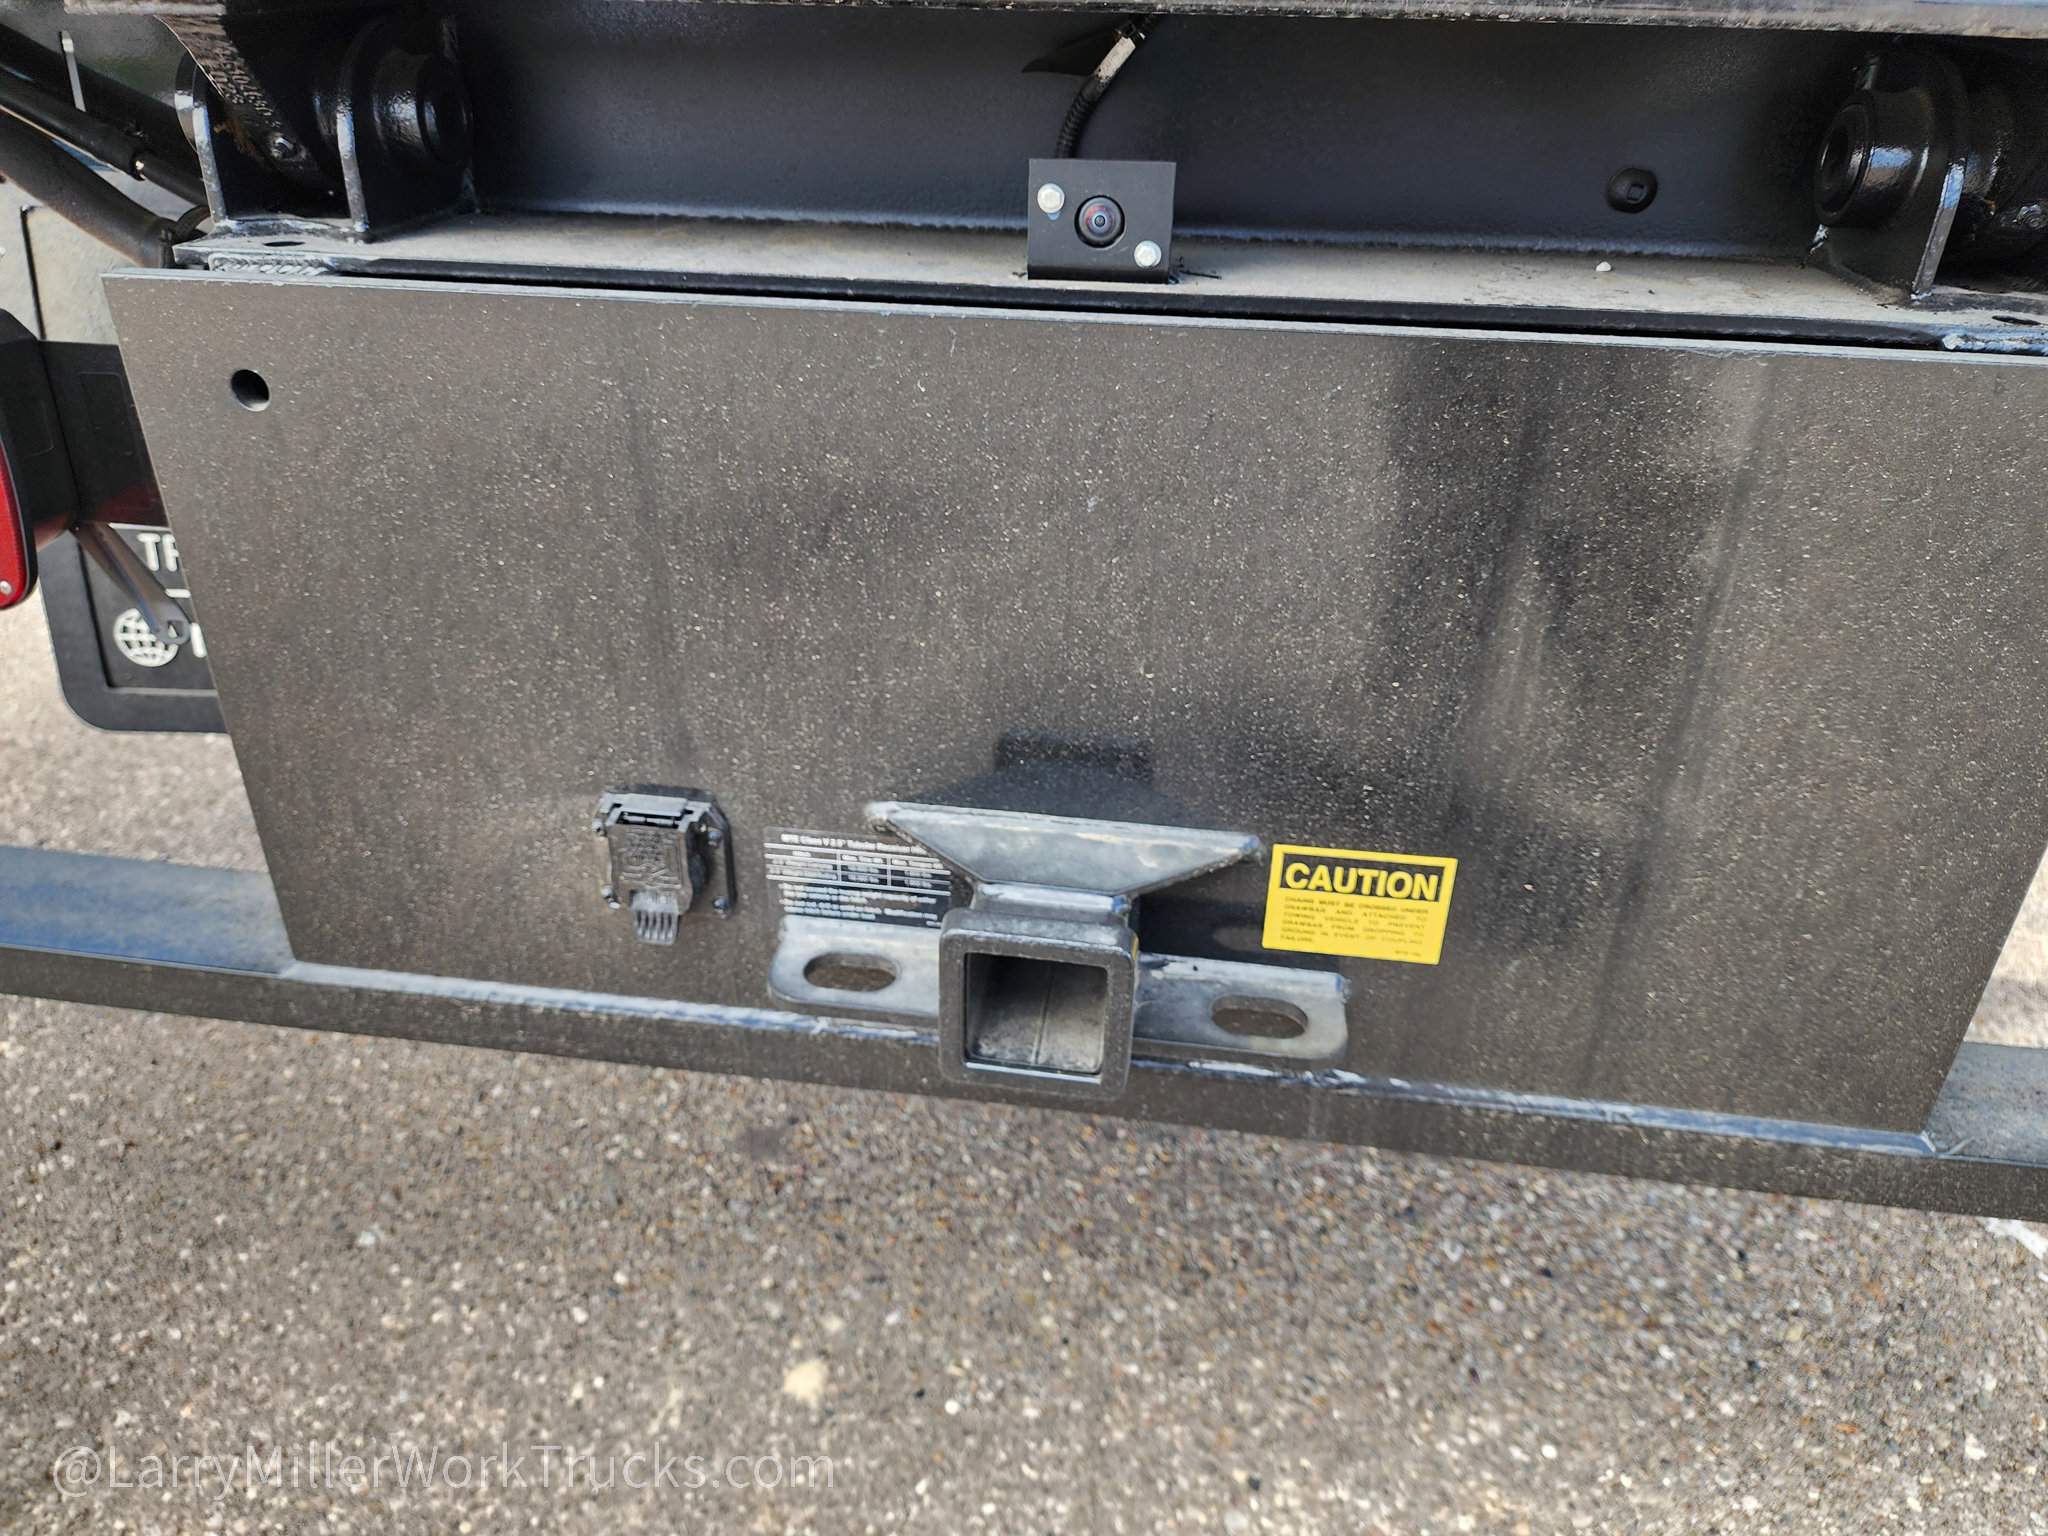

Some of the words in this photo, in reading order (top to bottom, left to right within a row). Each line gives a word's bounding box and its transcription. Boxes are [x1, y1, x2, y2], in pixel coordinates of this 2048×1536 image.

[1285, 862, 1439, 901] CAUTION
[1318, 898, 1341, 907] MUST
[1344, 901, 1354, 909] BE
[1400, 907, 1429, 915] UNDER
[1362, 911, 1406, 920] ATTACHED
[1283, 911, 1315, 920] TOWING
[1324, 915, 1359, 924] VEHICLE
[1388, 921, 1426, 930] PREVENT
